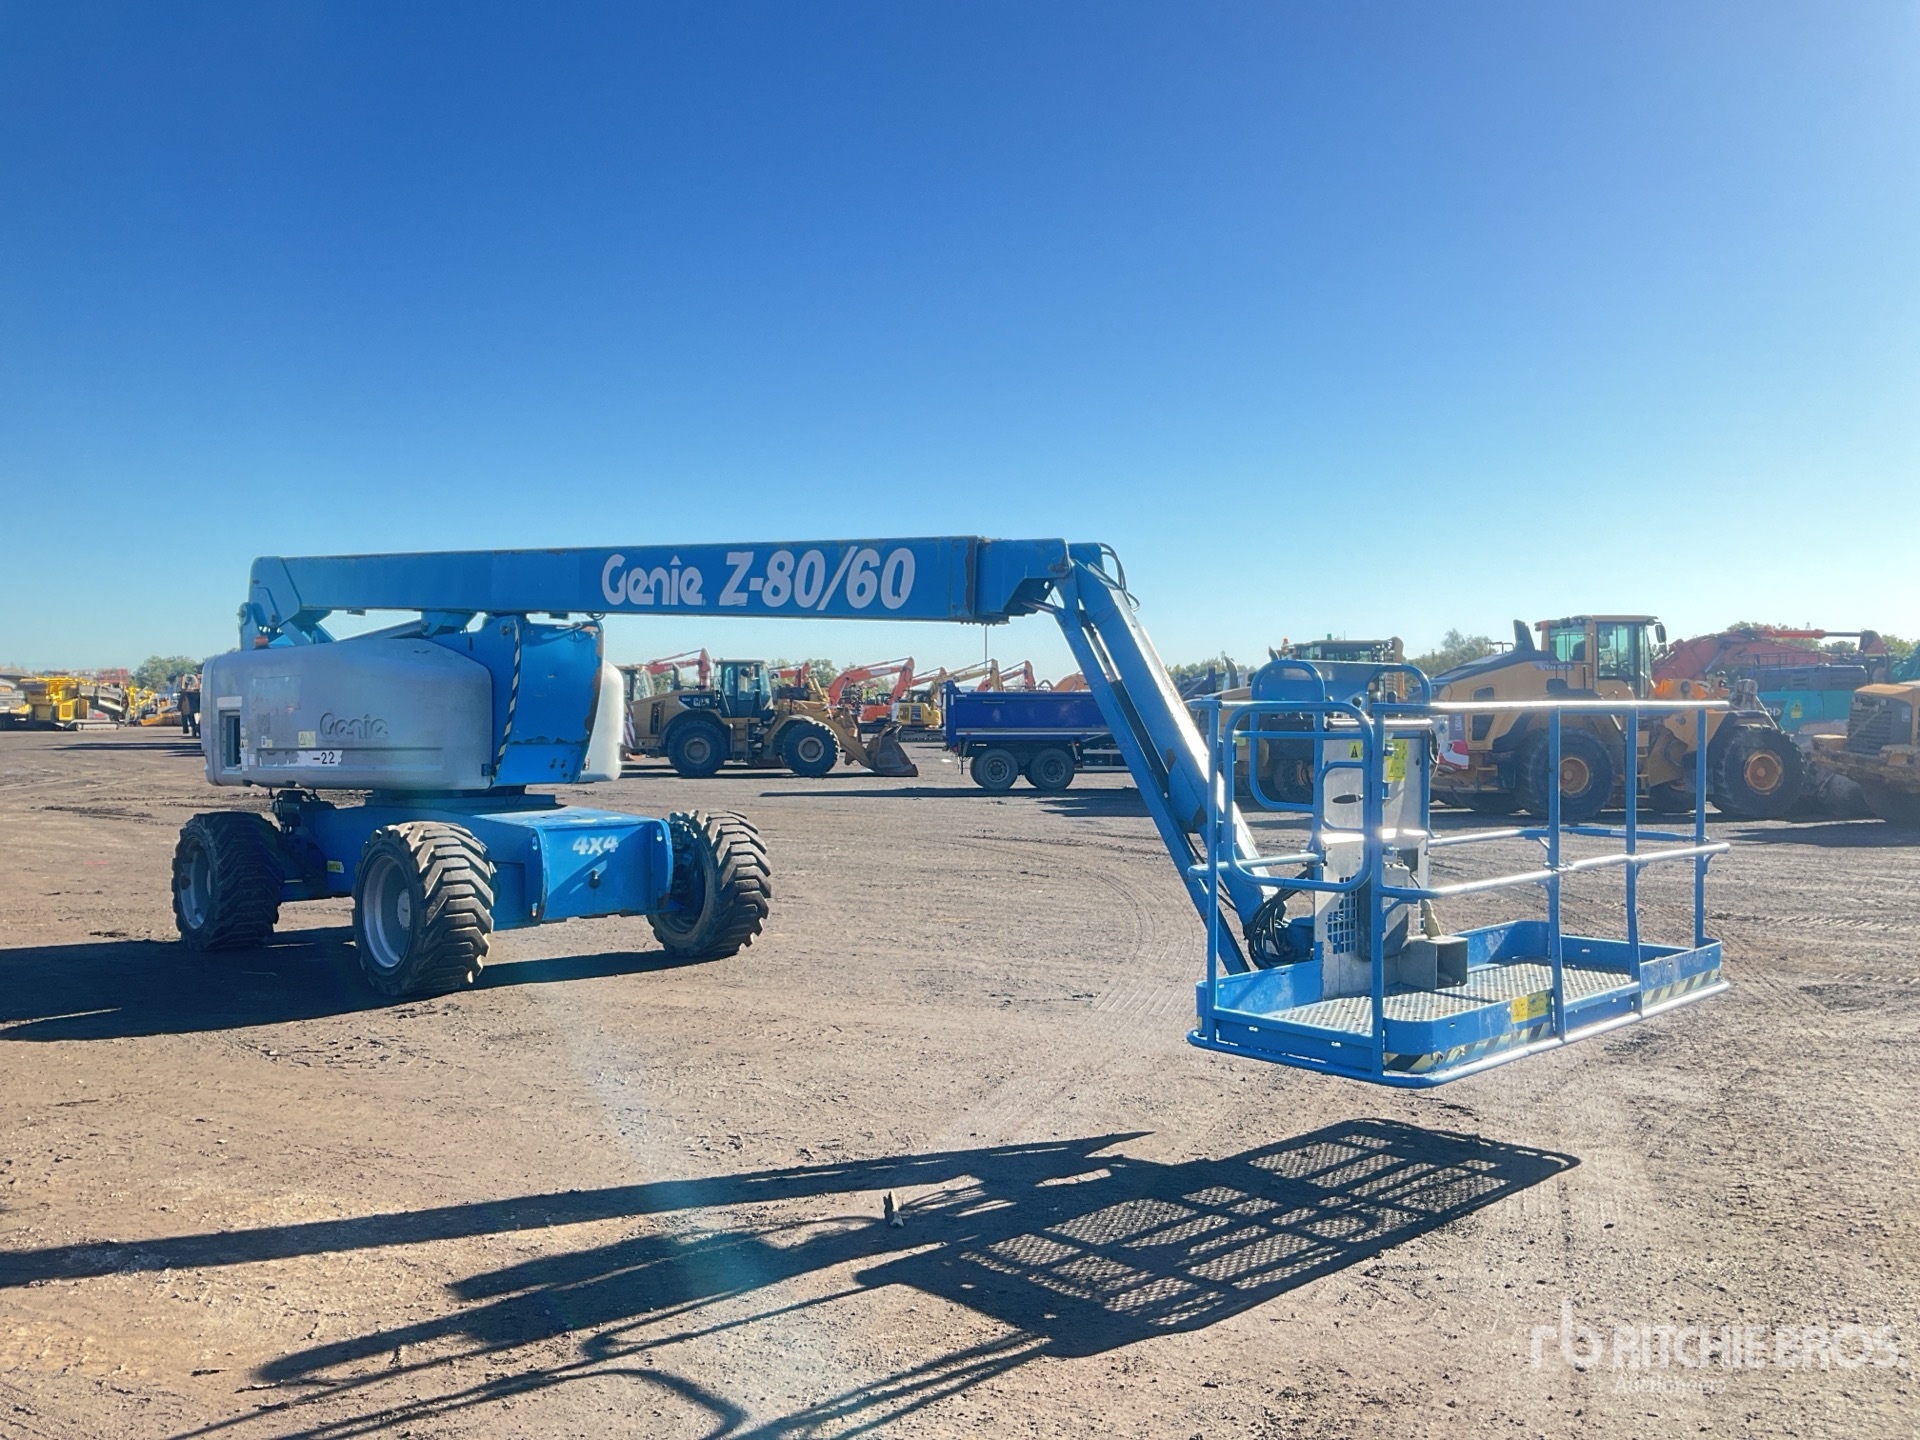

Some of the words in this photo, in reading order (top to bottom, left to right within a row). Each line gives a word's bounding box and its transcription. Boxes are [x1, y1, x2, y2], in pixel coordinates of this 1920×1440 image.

[602, 554, 705, 606] Genie
[718, 546, 915, 611] Z-80/60
[319, 711, 390, 740] Genie
